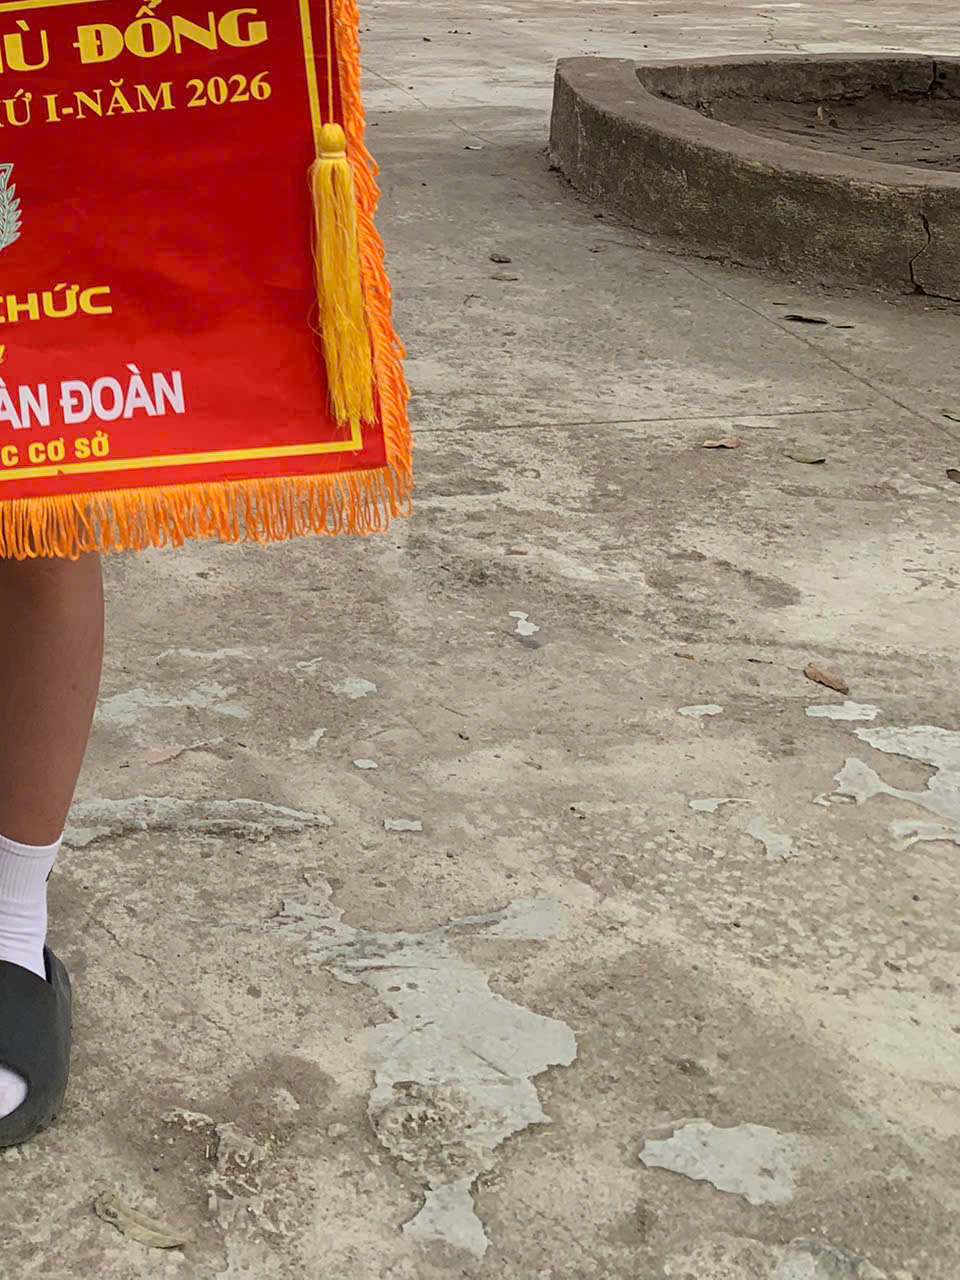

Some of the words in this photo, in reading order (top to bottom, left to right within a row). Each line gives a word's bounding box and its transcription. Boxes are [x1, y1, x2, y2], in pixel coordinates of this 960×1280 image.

[44, 78, 176, 123] I-NĂM
[186, 71, 272, 108] 2026
[60, 363, 185, 424] ĐOÀN
[28, 436, 67, 461] CƠ
[74, 430, 110, 458] SỞ
